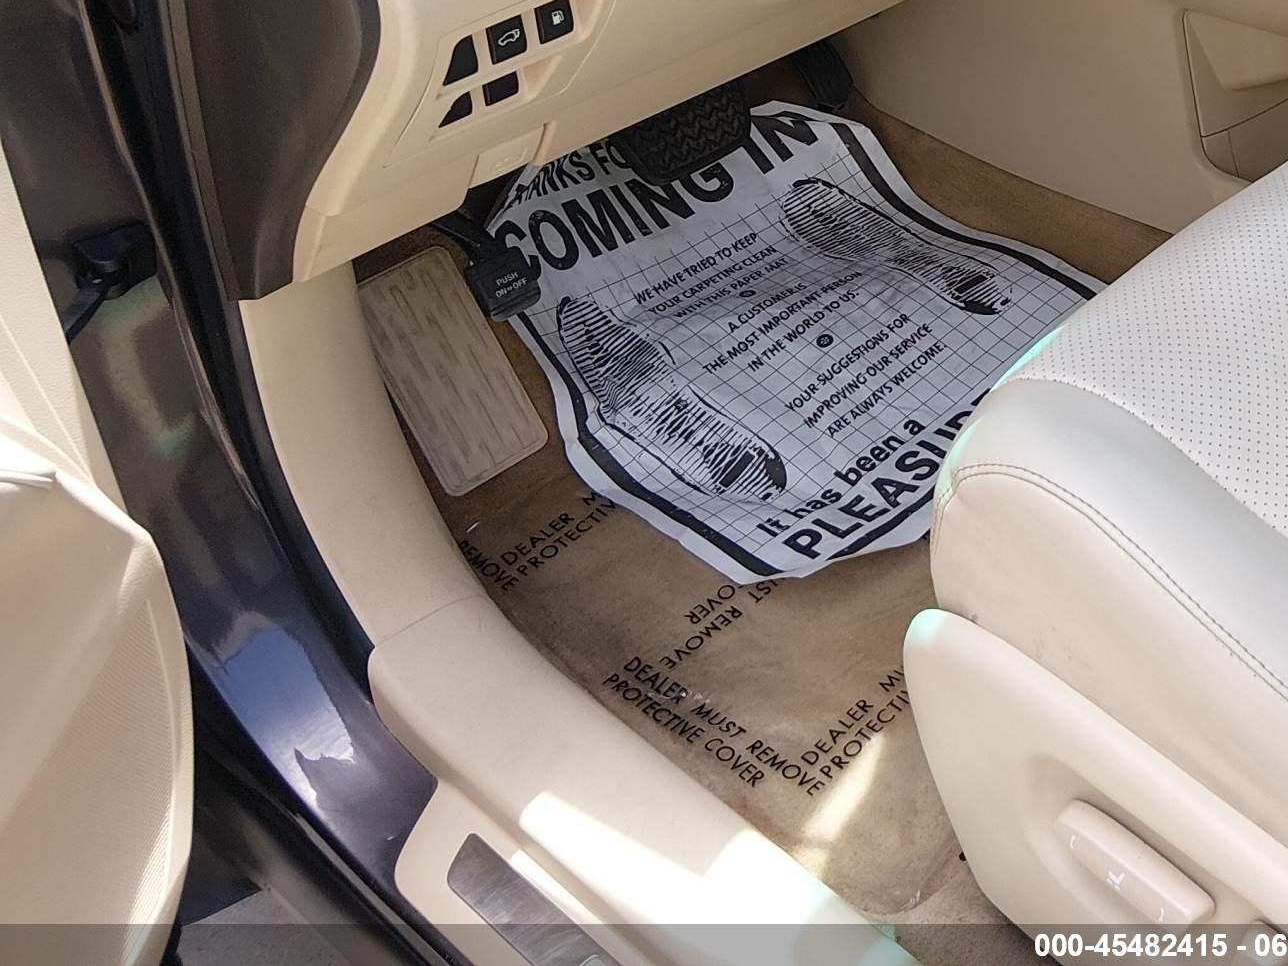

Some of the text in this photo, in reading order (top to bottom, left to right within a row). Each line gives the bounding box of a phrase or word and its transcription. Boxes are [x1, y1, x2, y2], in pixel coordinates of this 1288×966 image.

[588, 141, 631, 175] FO
[495, 112, 819, 280] COMING IN
[495, 271, 519, 287] PUSH
[512, 277, 528, 290] OFF
[633, 232, 760, 305] WE HAVE TRIED TO KEEP
[649, 244, 778, 315] YOUR CARPETING CLEAN
[674, 257, 790, 318] WITH THIS PAPER MAT
[703, 271, 863, 375] THE MOST IMPORTANT PERSON
[727, 282, 808, 334] A CUSTOMER IS
[749, 288, 861, 373] IN THE WORLD TO US.
[785, 313, 912, 412] YOUR SUGGESTIONS FOR
[804, 323, 933, 430] IMPROVING OUR SERVICE
[826, 343, 949, 438] ARE ALWAYS WELCOME.
[756, 419, 927, 538] It has been a
[782, 388, 991, 559] PLEASU
[459, 540, 520, 591] REMOVE
[500, 512, 575, 566] DEALER
[516, 500, 618, 577] PROTECTIV
[659, 605, 744, 670] REMOVE
[683, 584, 743, 626] OVER
[602, 673, 766, 788] PROTECTIVE COVER
[623, 656, 827, 797] DEALER MUST REMOVE
[801, 699, 875, 767] DEALER
